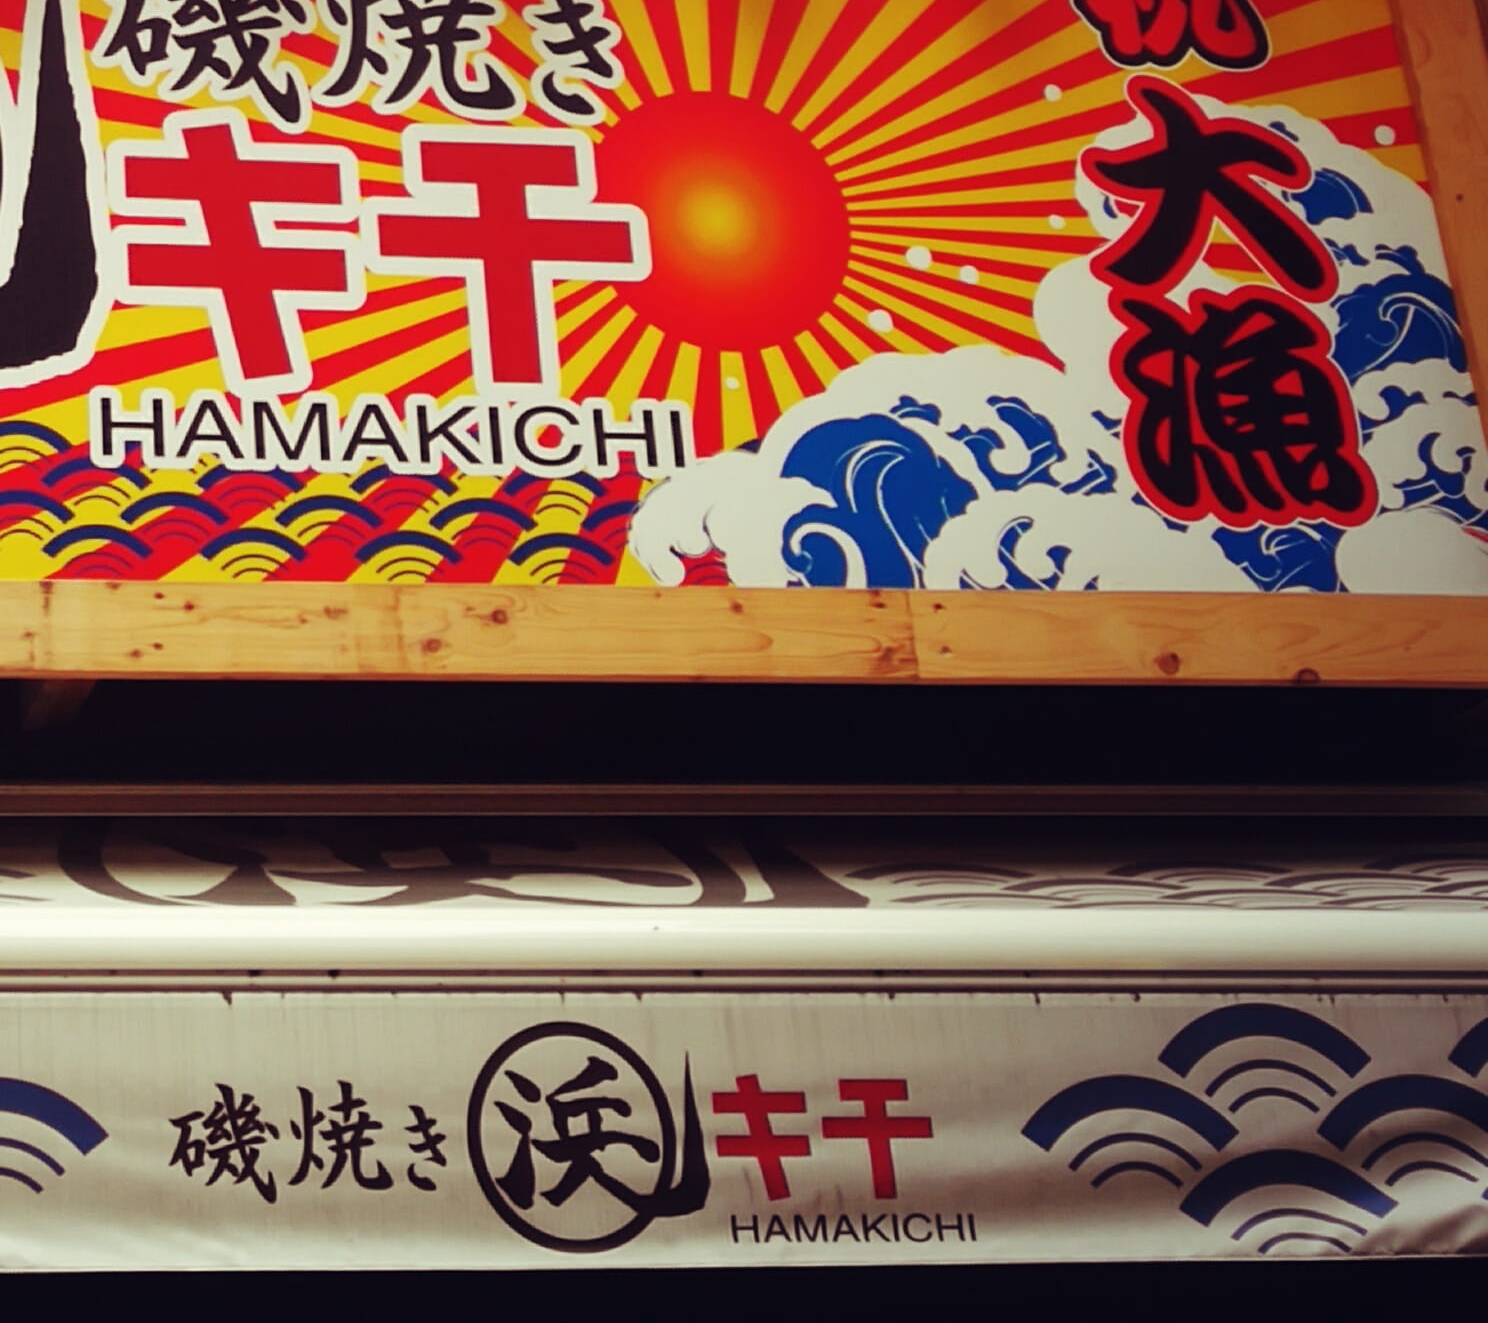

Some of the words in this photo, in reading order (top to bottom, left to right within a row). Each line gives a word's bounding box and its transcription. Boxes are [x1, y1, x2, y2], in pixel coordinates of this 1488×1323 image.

[1080, 74, 1380, 528] 大漁
[98, 396, 688, 468] HAMAKICHI
[168, 1081, 448, 1205] 磯焼き
[729, 1212, 977, 1245] HAMAKICHI
